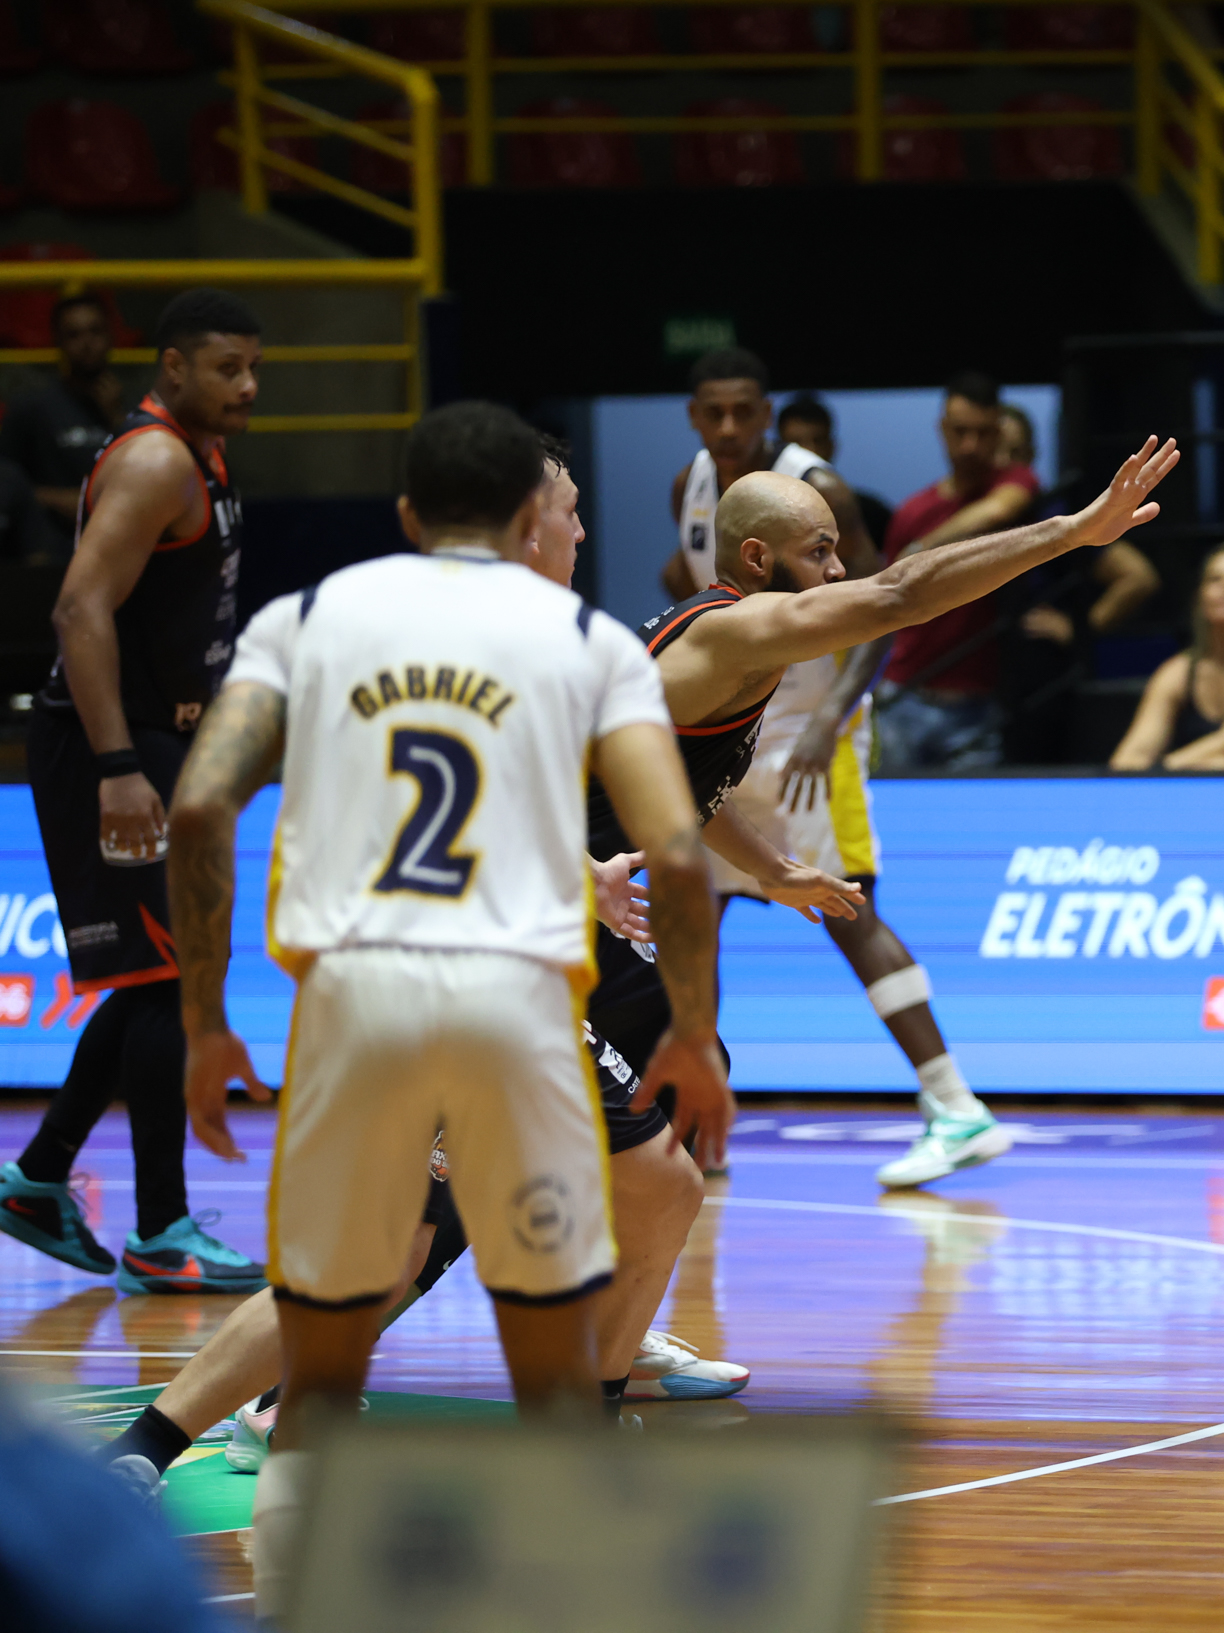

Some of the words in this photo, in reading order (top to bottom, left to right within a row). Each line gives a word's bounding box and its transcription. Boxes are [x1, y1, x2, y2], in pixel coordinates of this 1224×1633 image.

[350, 663, 513, 730] GABRIEL
[368, 725, 483, 902] 2
[1005, 838, 1160, 885] PEDÁGIO
